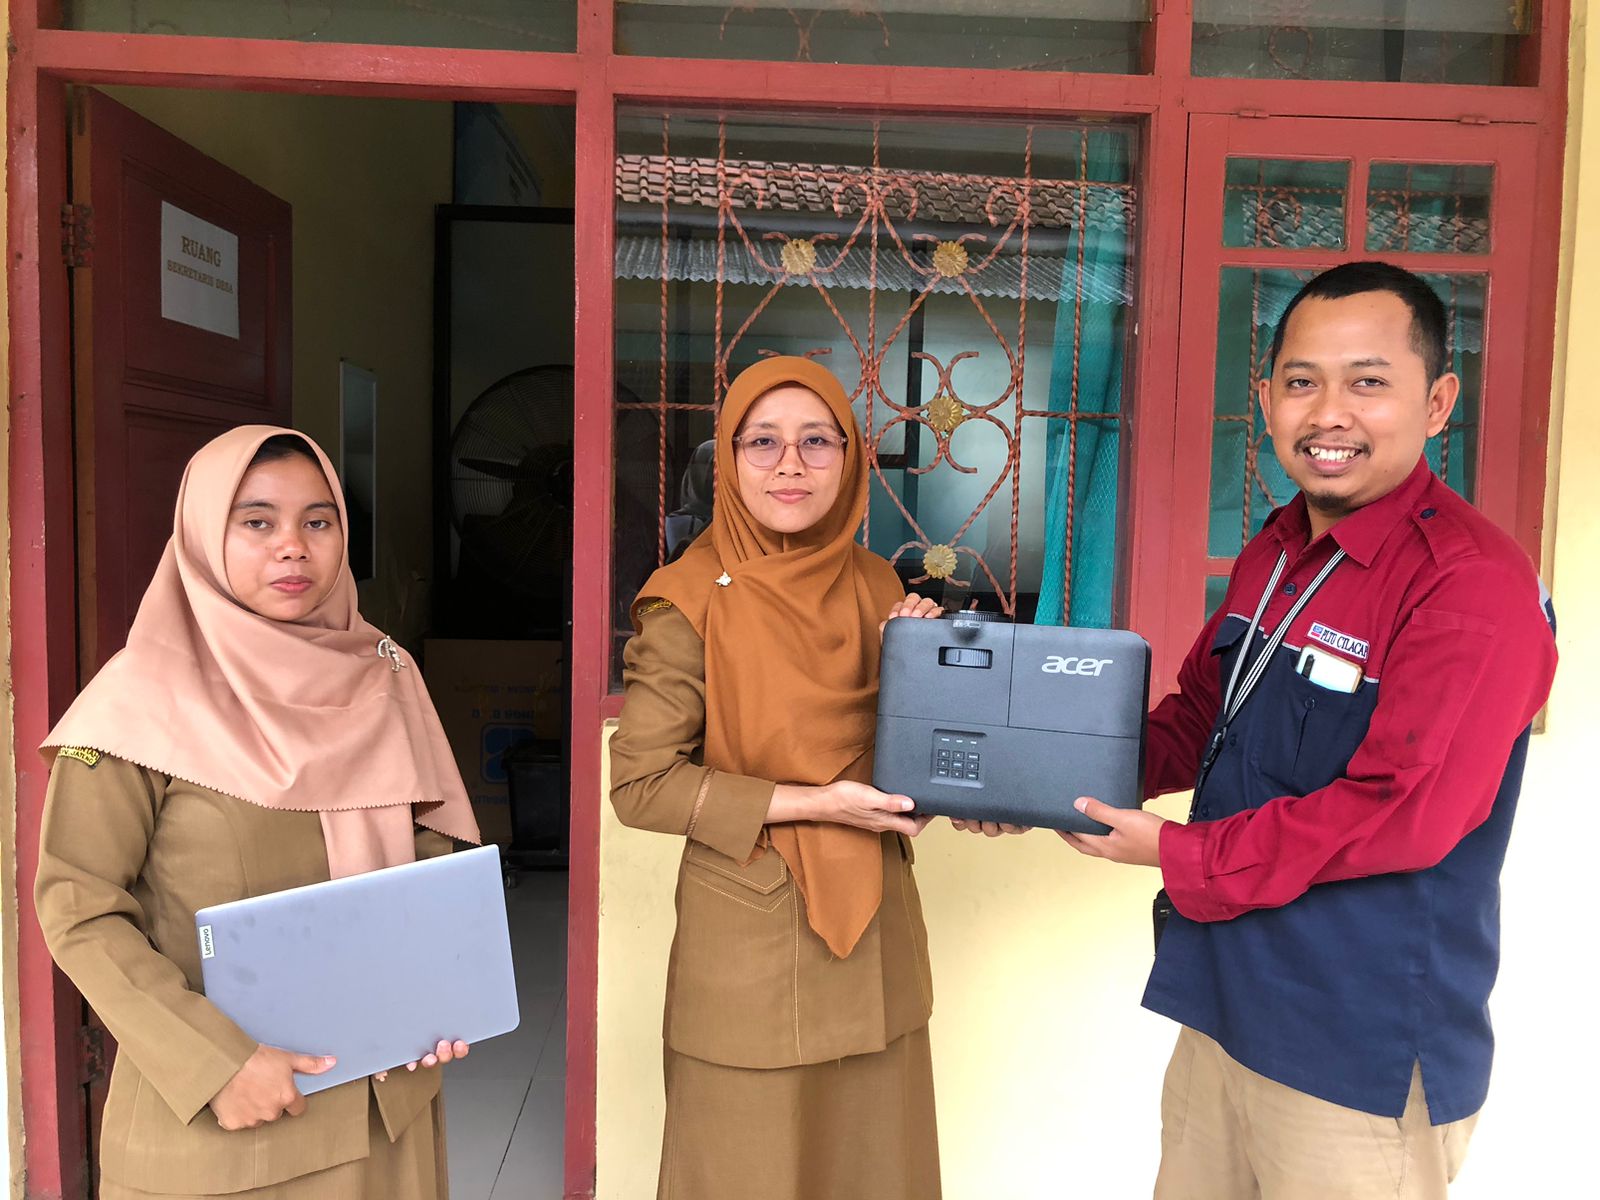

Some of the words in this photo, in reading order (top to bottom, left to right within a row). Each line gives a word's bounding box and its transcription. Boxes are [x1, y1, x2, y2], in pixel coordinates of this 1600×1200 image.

[181, 235, 221, 268] RUANG
[167, 260, 215, 287] SEKRETARIS
[215, 279, 234, 295] DESA
[1320, 629, 1338, 645] PLTU
[1041, 655, 1114, 677] acer
[203, 928, 212, 956] Lenovo
